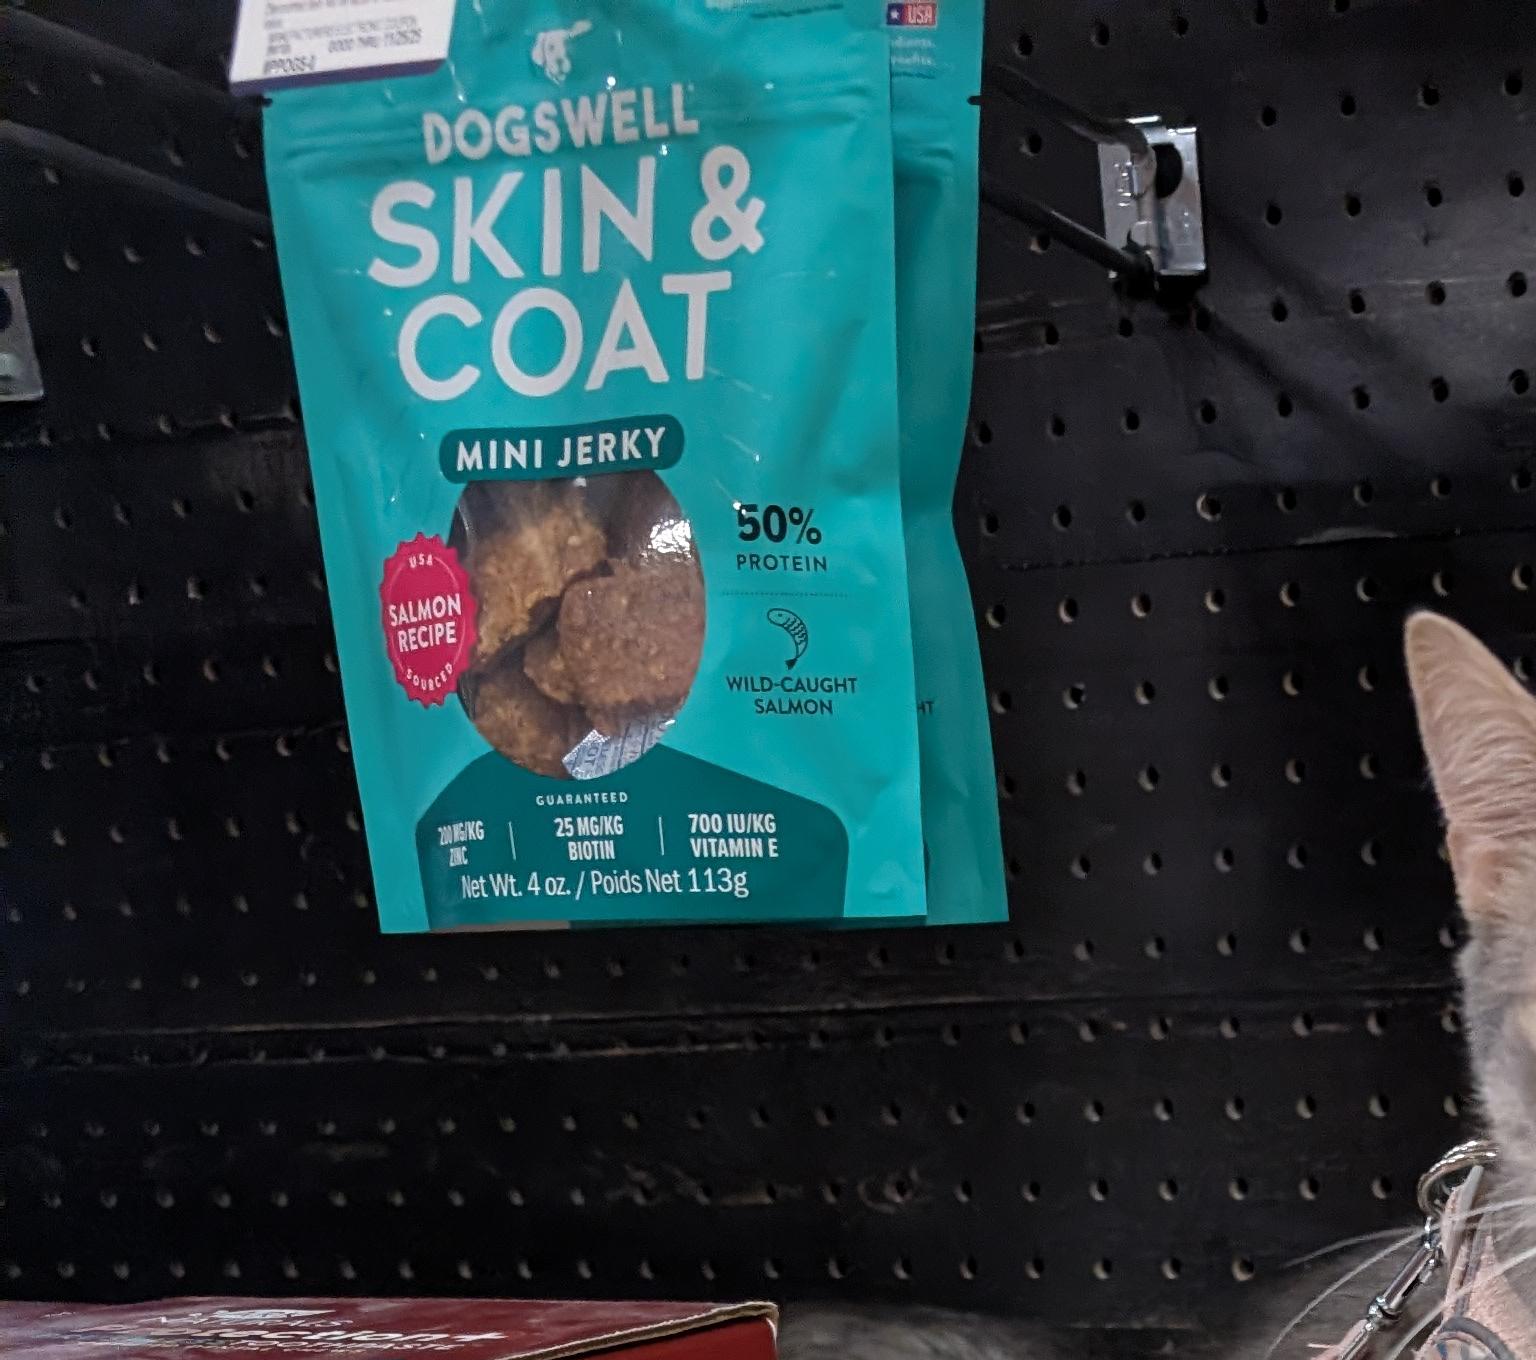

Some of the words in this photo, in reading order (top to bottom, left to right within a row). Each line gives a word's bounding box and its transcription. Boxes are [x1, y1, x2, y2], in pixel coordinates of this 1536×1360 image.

[908, 3, 933, 24] USA
[421, 83, 699, 165] DOGSWELL
[368, 156, 658, 287] SKIN
[691, 146, 766, 260] &
[397, 271, 733, 401] COAT
[456, 438, 542, 472] MINI
[557, 427, 667, 468] JERKY
[737, 503, 822, 545] 50%
[408, 553, 433, 569] USA
[737, 553, 828, 571] PROTEIN
[389, 593, 462, 627] SALMON
[398, 621, 457, 652] RECIPE
[407, 662, 453, 691] SOURCED
[727, 676, 857, 693] WILD-CAUGHT
[755, 698, 833, 715] SALMON
[536, 791, 628, 806] GUARANTEED
[554, 817, 575, 837] 25
[577, 815, 624, 837] MG/KG
[688, 814, 722, 834] 700
[727, 813, 777, 834] IU/KG
[449, 847, 468, 867] ZINC
[568, 840, 615, 861] BIOTIN
[690, 838, 764, 858] VITAMIN
[768, 838, 779, 858] E
[461, 875, 485, 900] Net
[489, 874, 523, 898] Wt.
[527, 873, 541, 895] 4
[545, 875, 571, 897] oz.
[575, 871, 584, 900] /
[591, 870, 642, 895] Poids
[646, 869, 680, 894] Net
[688, 867, 750, 898] 113g
